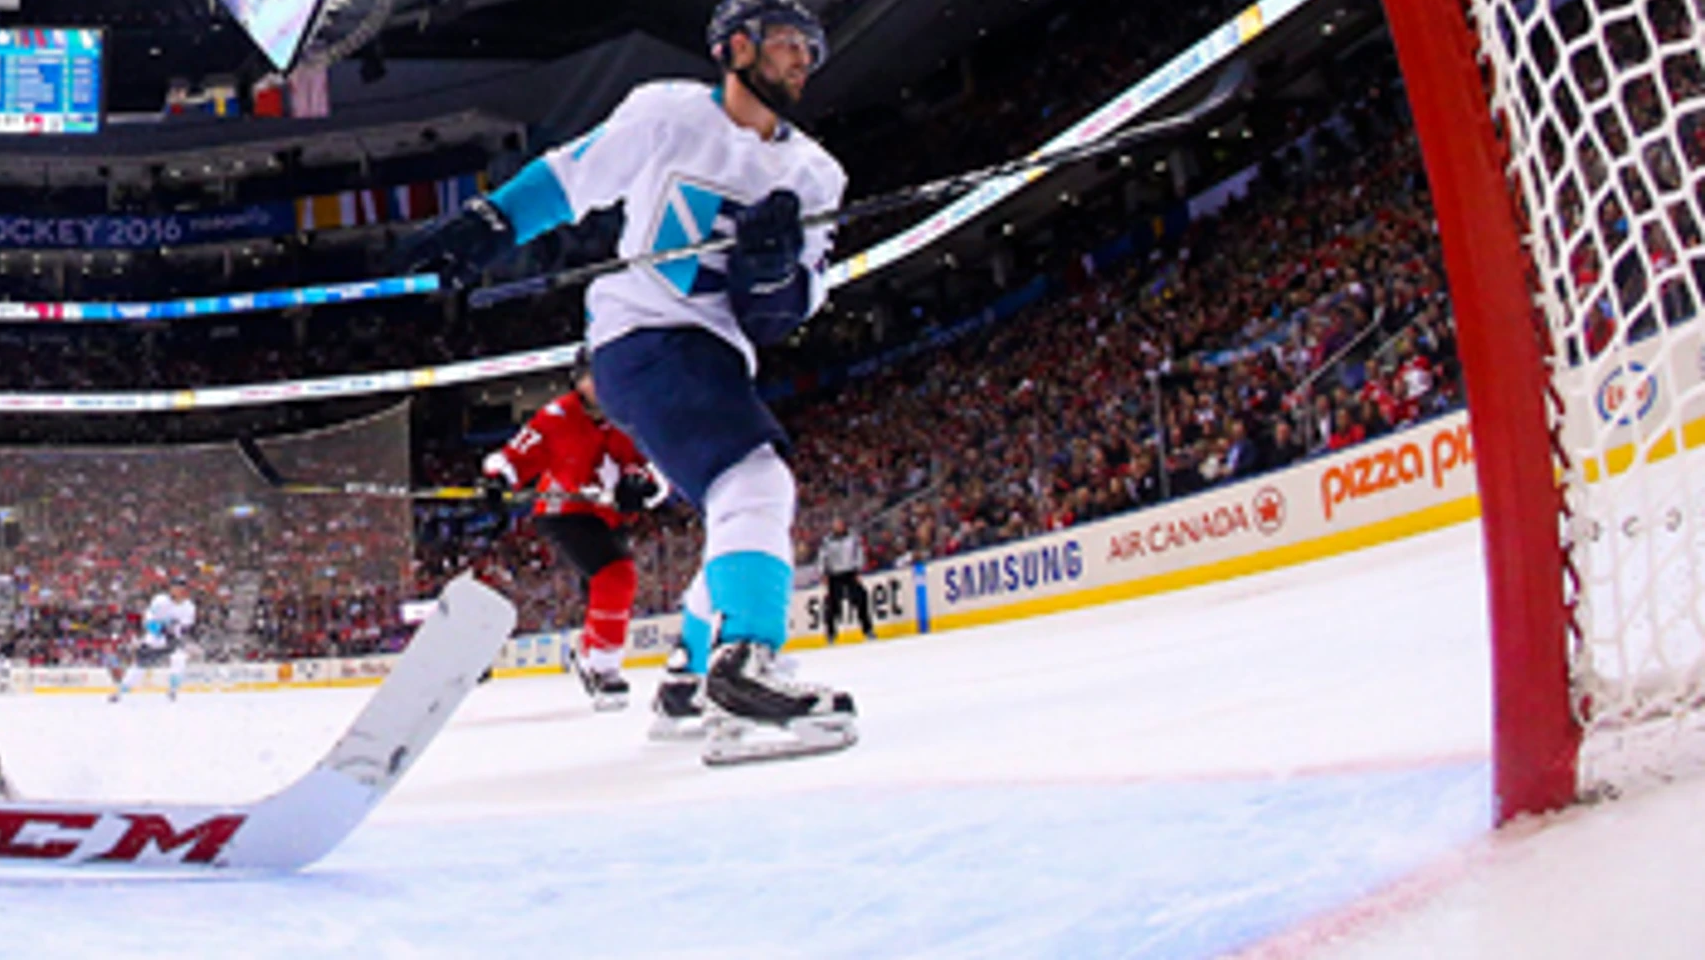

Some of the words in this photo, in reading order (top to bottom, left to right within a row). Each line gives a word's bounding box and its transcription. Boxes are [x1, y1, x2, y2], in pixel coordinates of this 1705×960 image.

[107, 217, 183, 246] 2016
[1320, 442, 1425, 522] pizza
[1106, 531, 1147, 562] AIR
[1147, 504, 1252, 554] CANADA
[943, 540, 1083, 603] SAMSUNG
